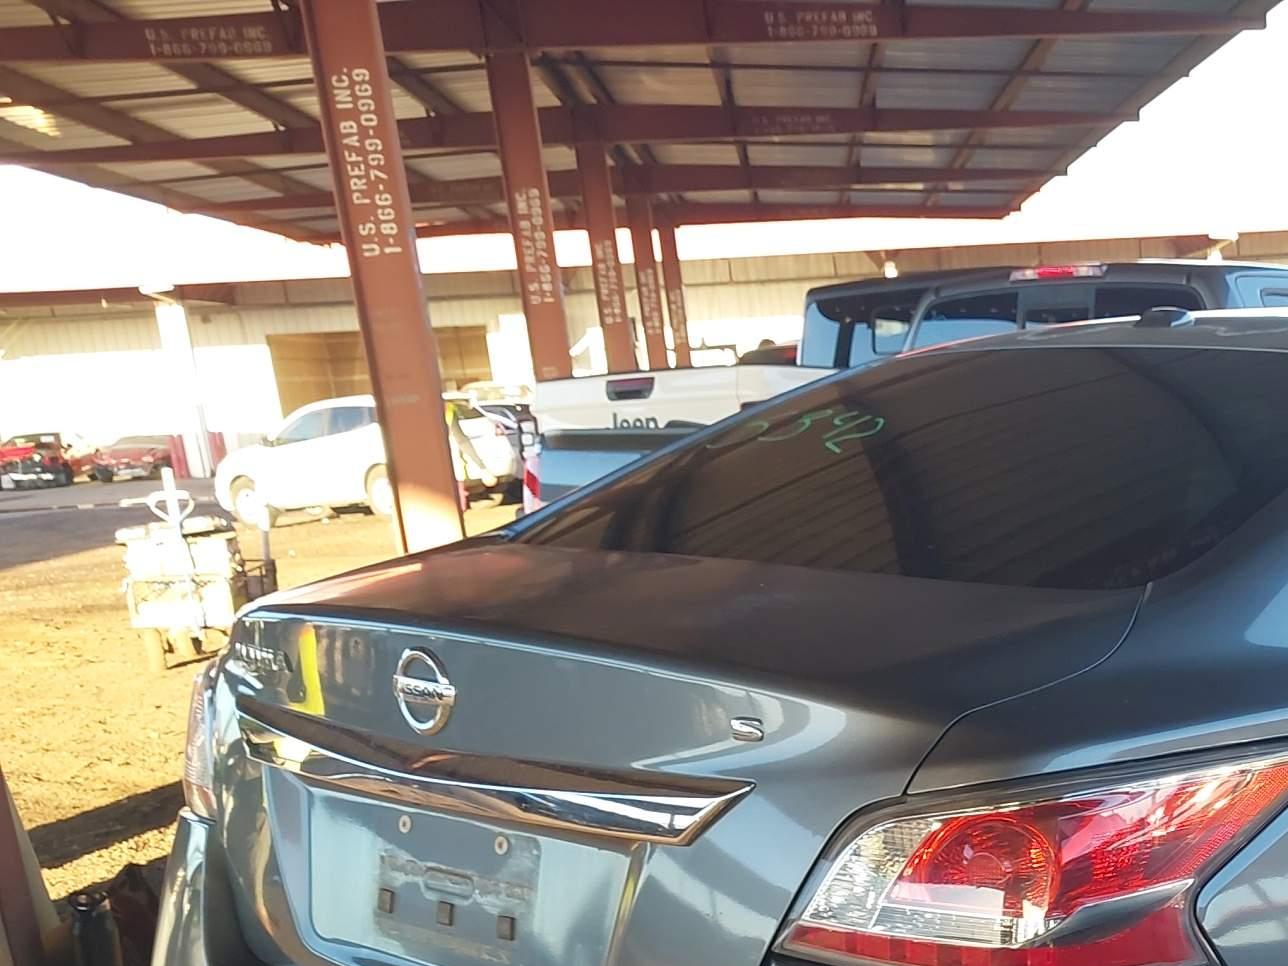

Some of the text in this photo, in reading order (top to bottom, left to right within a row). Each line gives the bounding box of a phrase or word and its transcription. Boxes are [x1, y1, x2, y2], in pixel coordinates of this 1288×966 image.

[331, 67, 381, 257] U.S. PREFAB INC.
[351, 67, 403, 255] 1-866-799-0969
[730, 716, 765, 742] S
